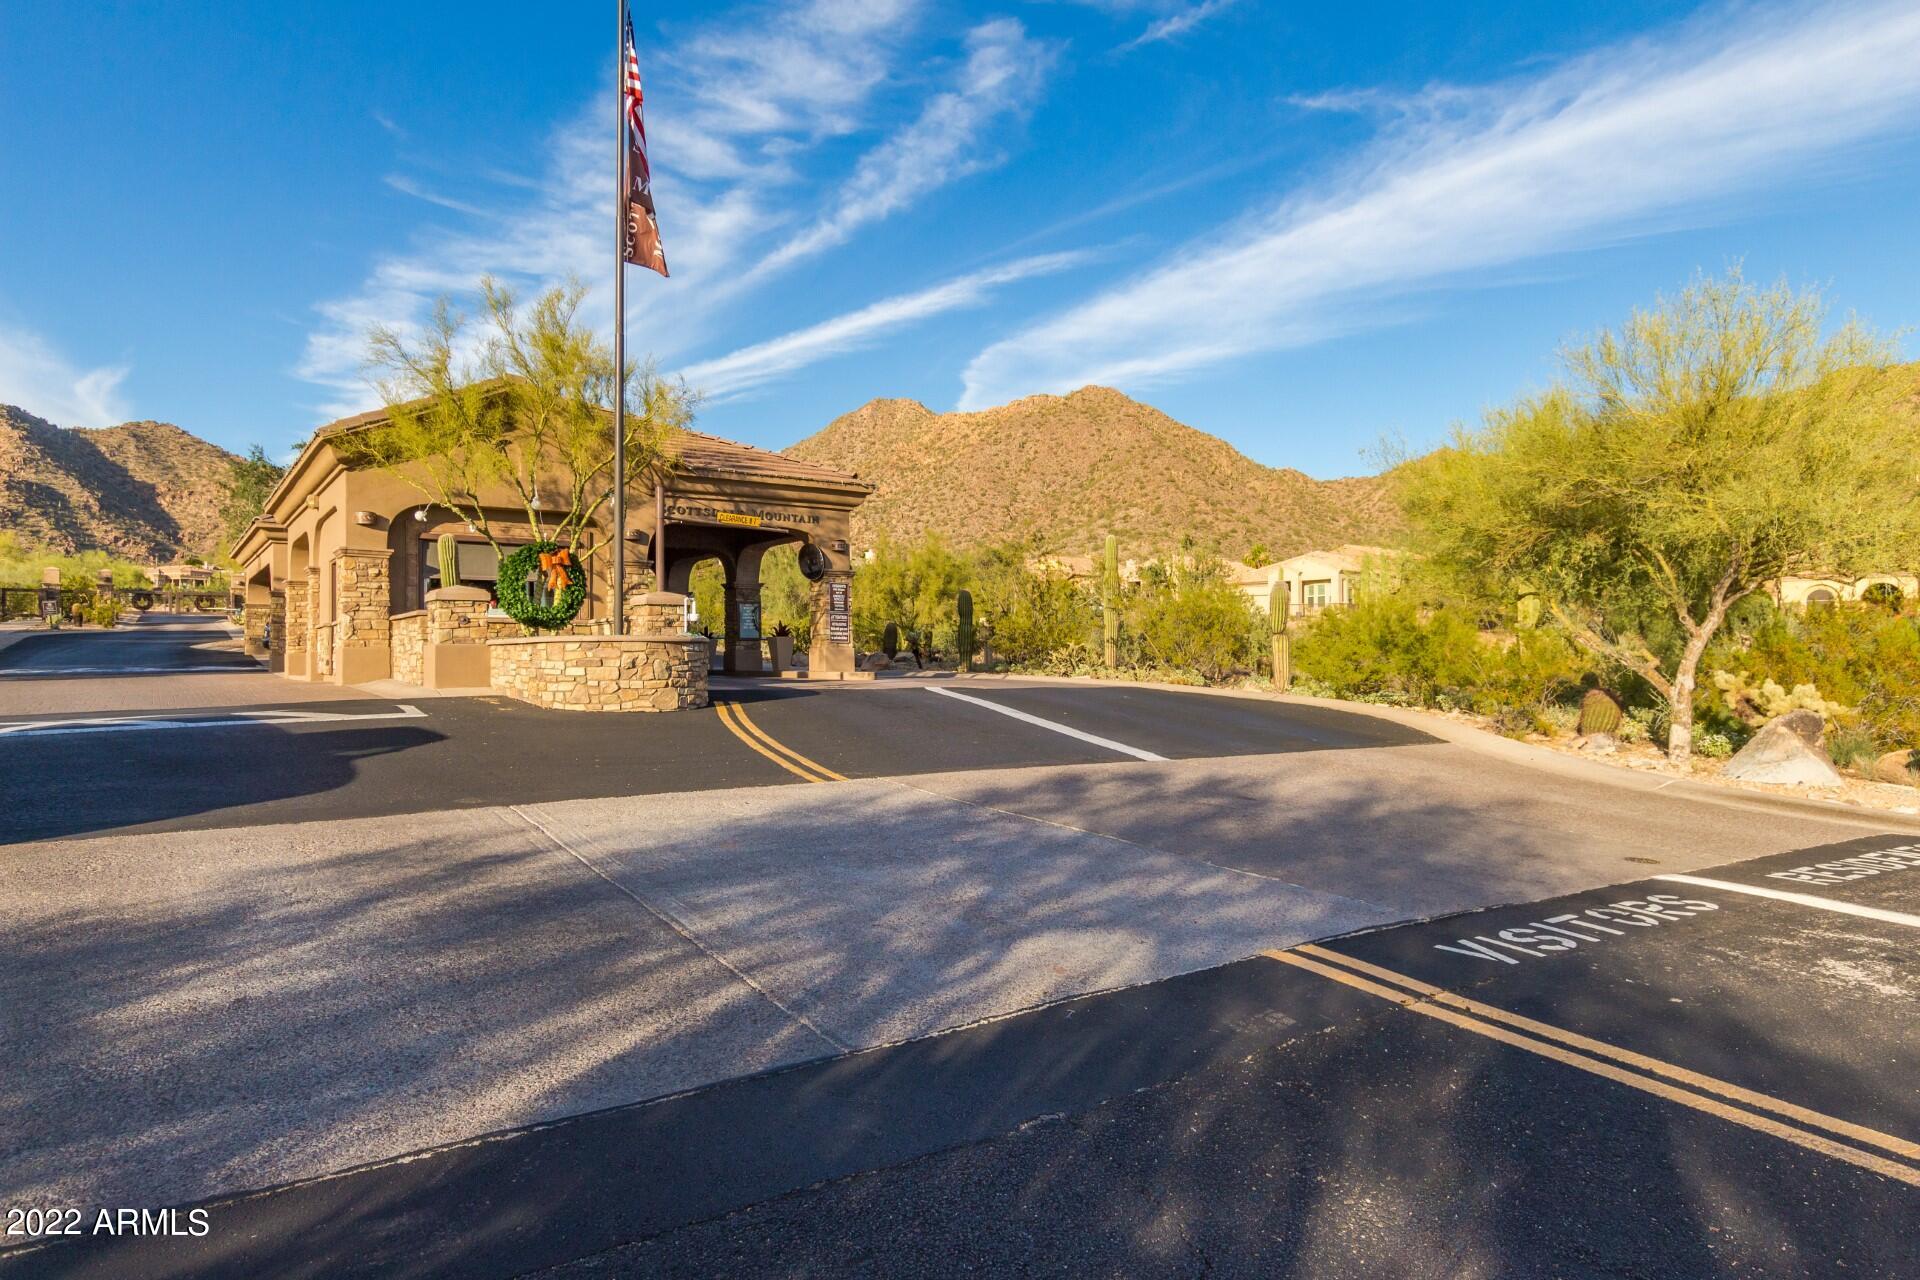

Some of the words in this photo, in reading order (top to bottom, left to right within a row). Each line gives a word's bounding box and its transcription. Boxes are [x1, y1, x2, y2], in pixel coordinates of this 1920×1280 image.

[719, 513, 748, 525] CLEARANCE
[753, 510, 820, 525] MOUNTAIN
[1764, 844, 1920, 886] RESIDEN
[1433, 894, 1719, 965] VISITORS
